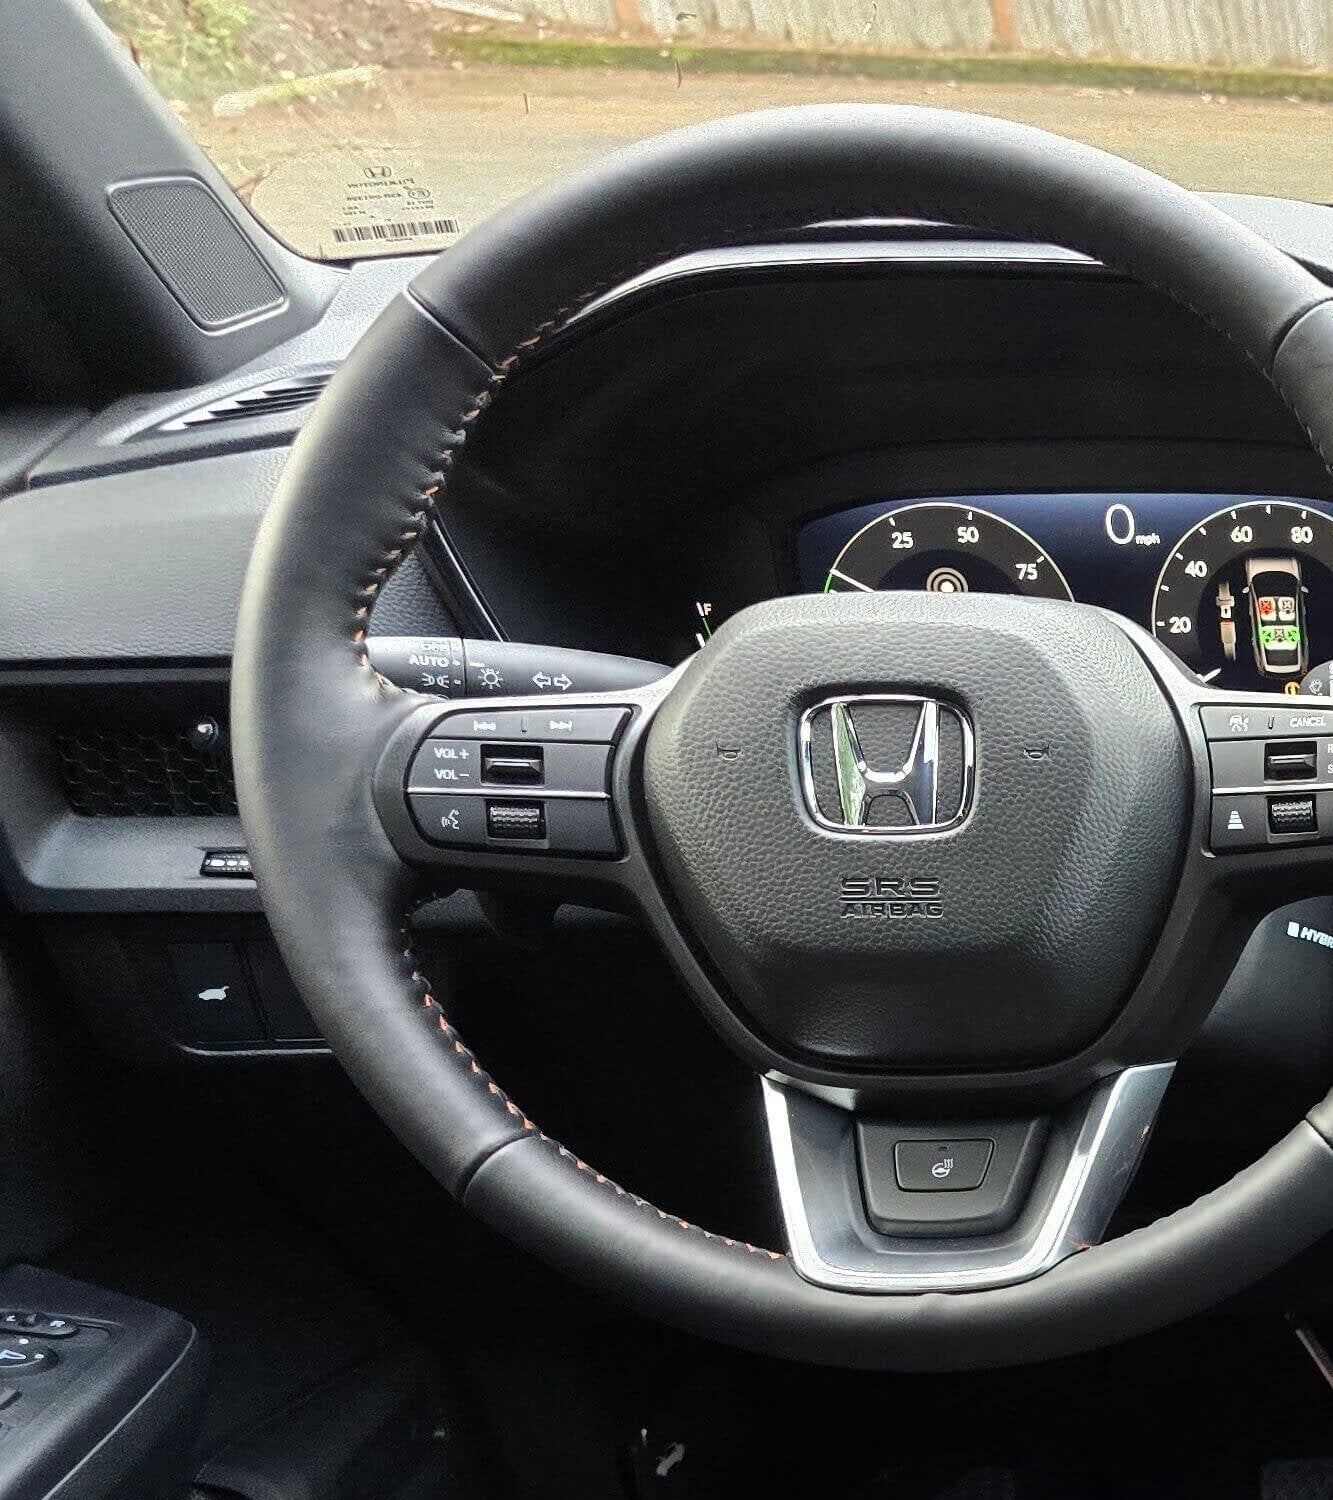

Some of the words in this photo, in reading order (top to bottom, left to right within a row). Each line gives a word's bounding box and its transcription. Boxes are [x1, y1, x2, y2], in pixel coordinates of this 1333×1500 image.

[1105, 503, 1135, 545] 0
[1135, 532, 1161, 547] mph
[891, 532, 914, 549] 25
[957, 526, 979, 543] 50
[1230, 525, 1253, 543] 60
[1290, 525, 1314, 543] 80
[1015, 562, 1038, 581] 75
[1184, 560, 1208, 577] 40
[703, 602, 712, 616] F
[1168, 616, 1192, 633] 20
[409, 654, 450, 668] AUTO
[1289, 716, 1327, 728] CANCEL
[839, 878, 940, 898] SRS
[839, 902, 944, 918] AIRBAG
